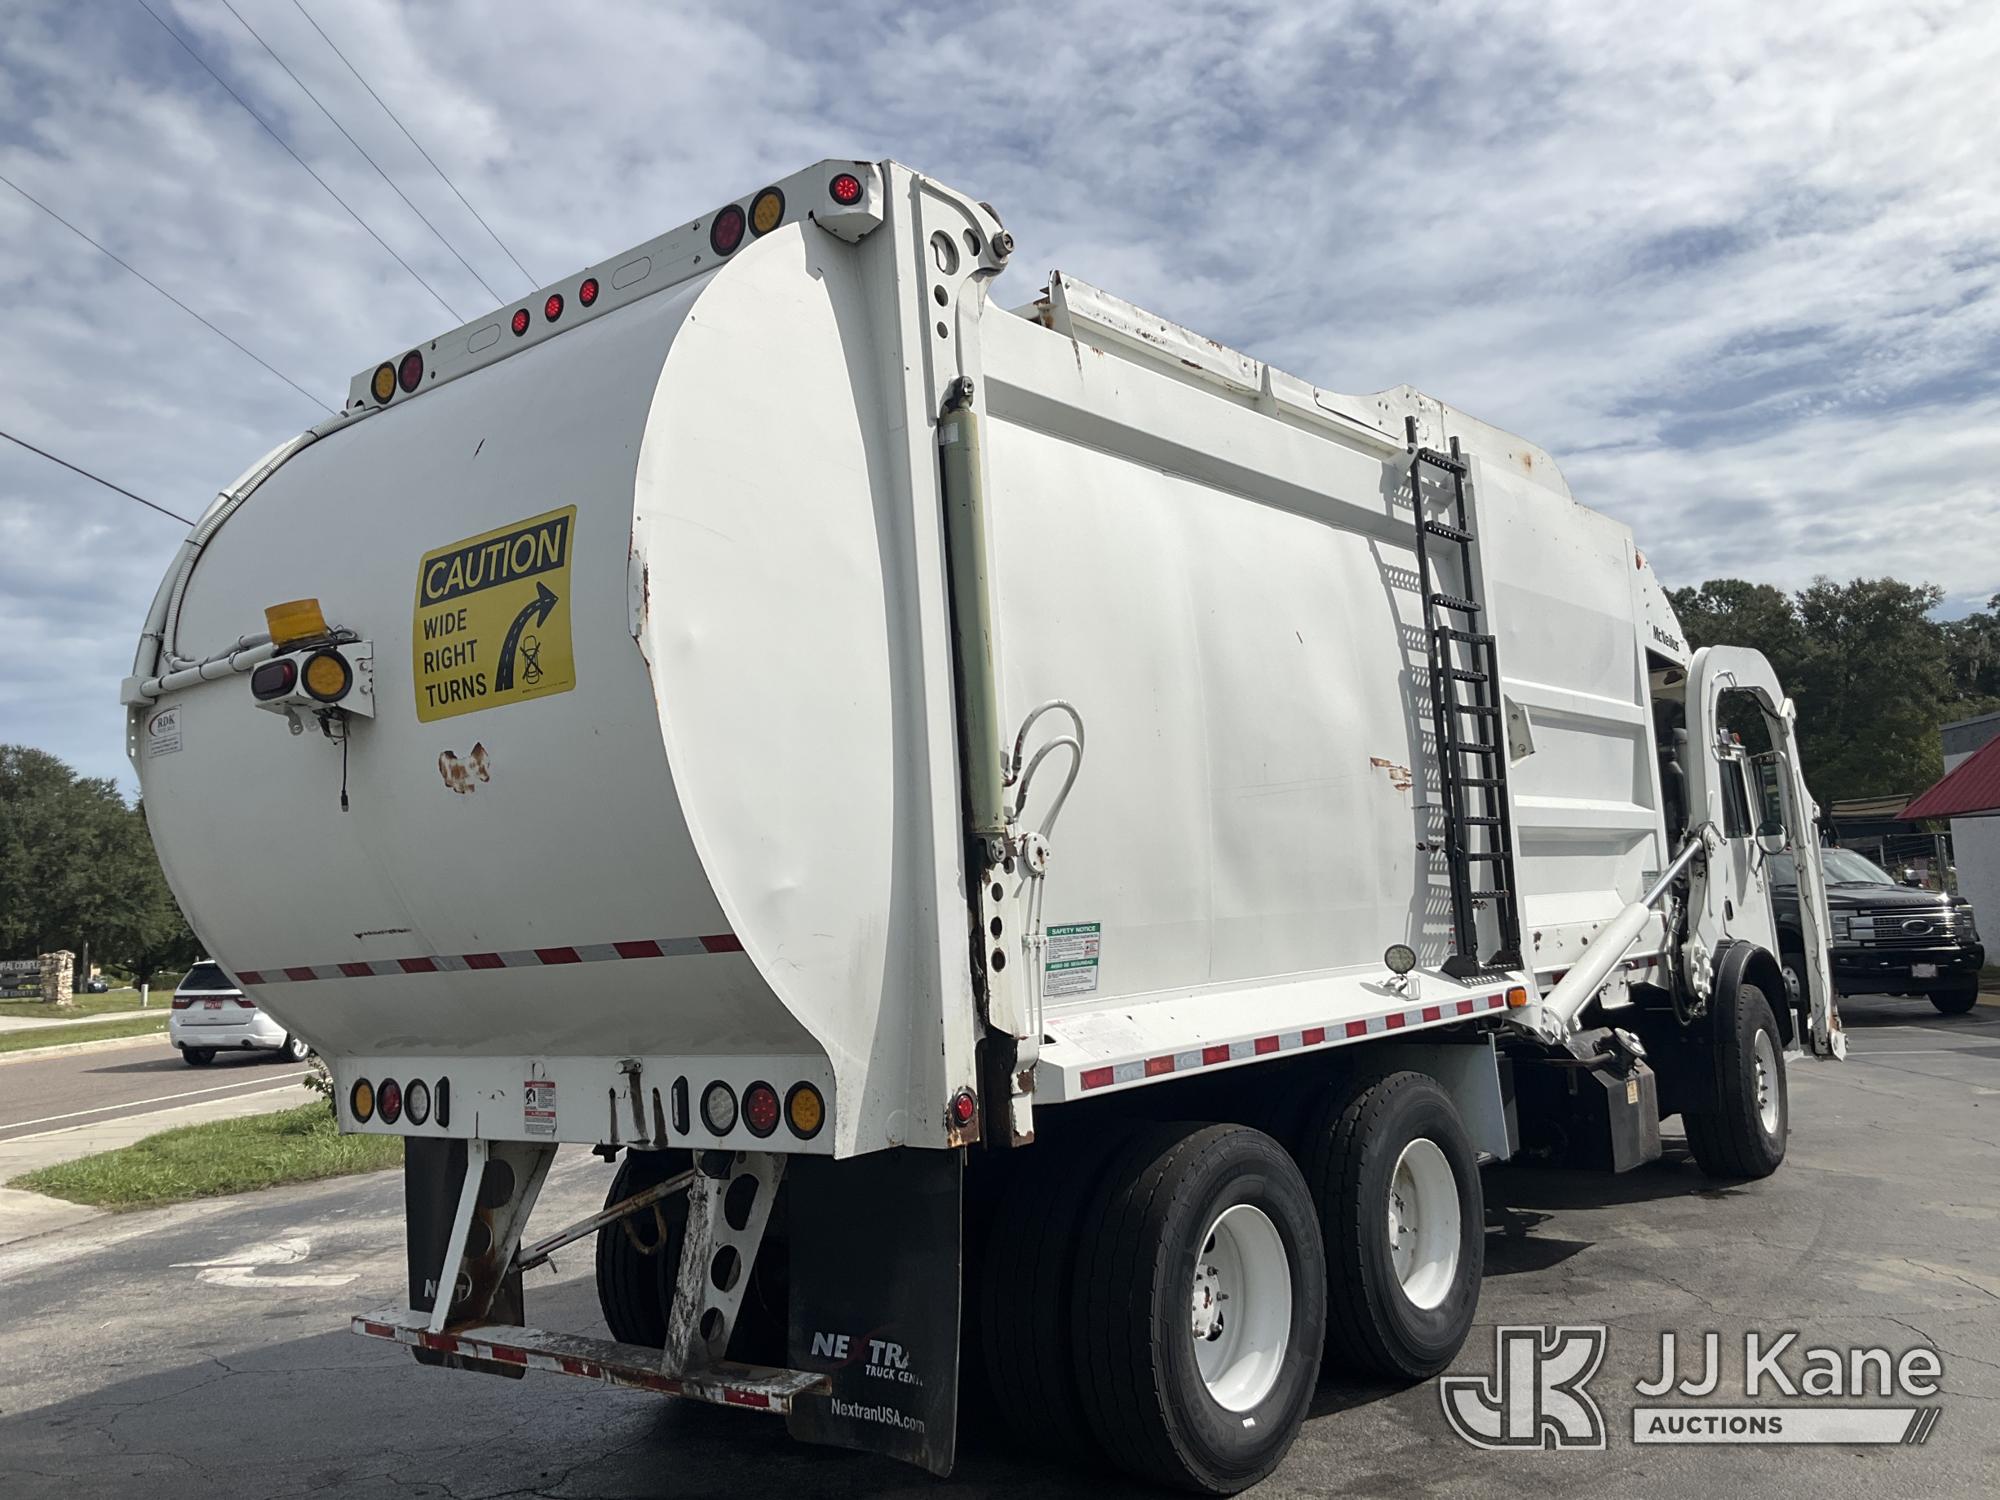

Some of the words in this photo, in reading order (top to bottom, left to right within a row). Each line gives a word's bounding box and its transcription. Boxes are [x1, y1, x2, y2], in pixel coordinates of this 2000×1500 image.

[424, 523, 562, 600] CAUTION
[423, 608, 467, 641] WIDE
[424, 639, 478, 675] RIGHT
[425, 672, 487, 708] TURNS
[157, 713, 176, 728] RDK
[865, 1364, 895, 1380] TRUCK
[897, 1370, 924, 1387] CEN
[831, 1398, 925, 1433] NextranUSA.com
